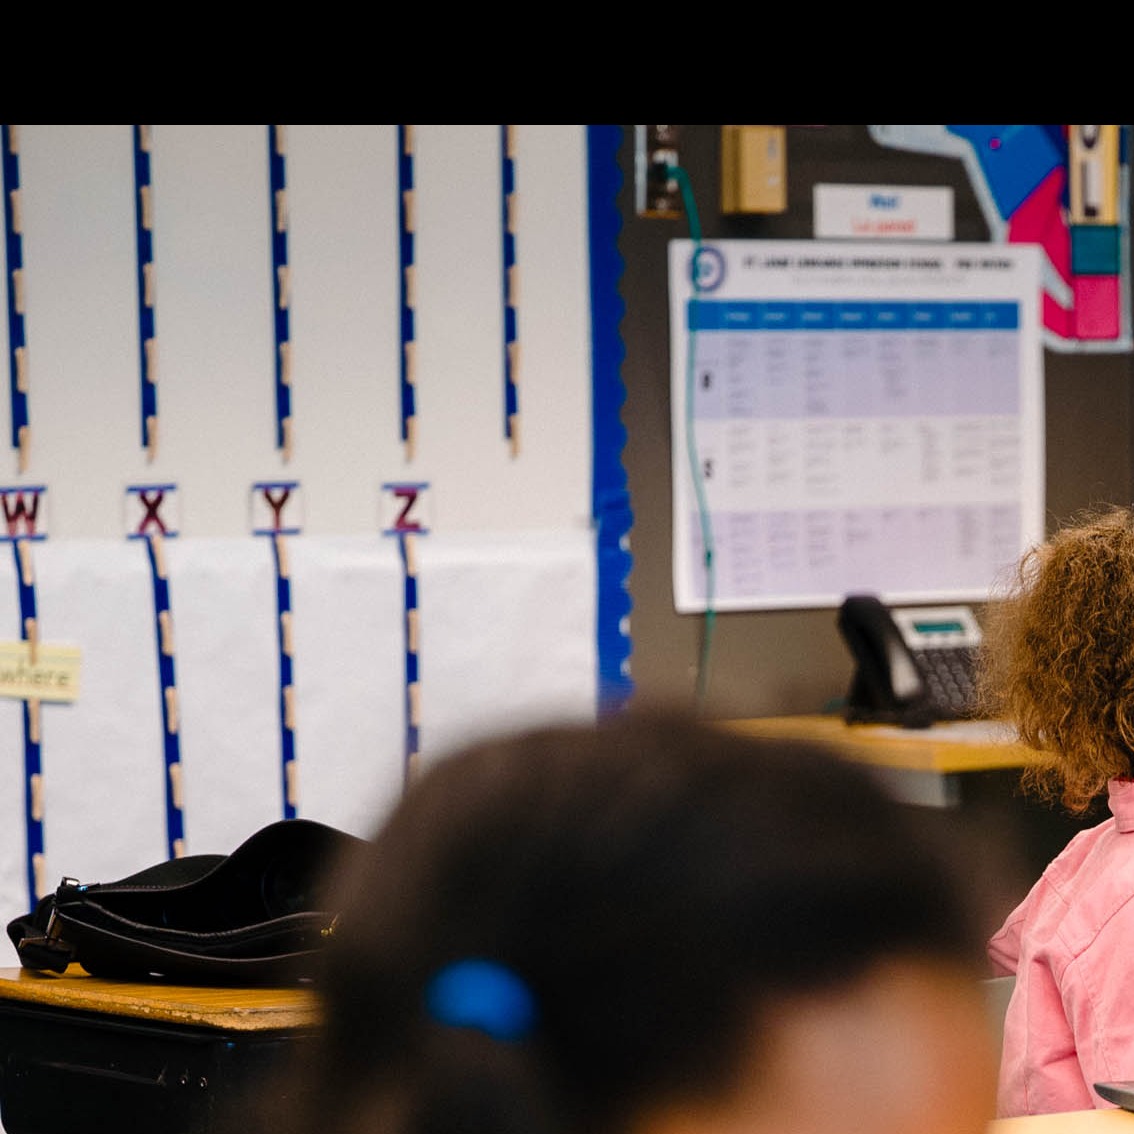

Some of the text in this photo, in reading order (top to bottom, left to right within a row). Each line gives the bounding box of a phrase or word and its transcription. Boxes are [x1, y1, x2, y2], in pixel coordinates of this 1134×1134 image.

[1, 490, 39, 536] W
[138, 488, 167, 535] X
[264, 486, 290, 532] Y
[393, 486, 421, 532] Z
